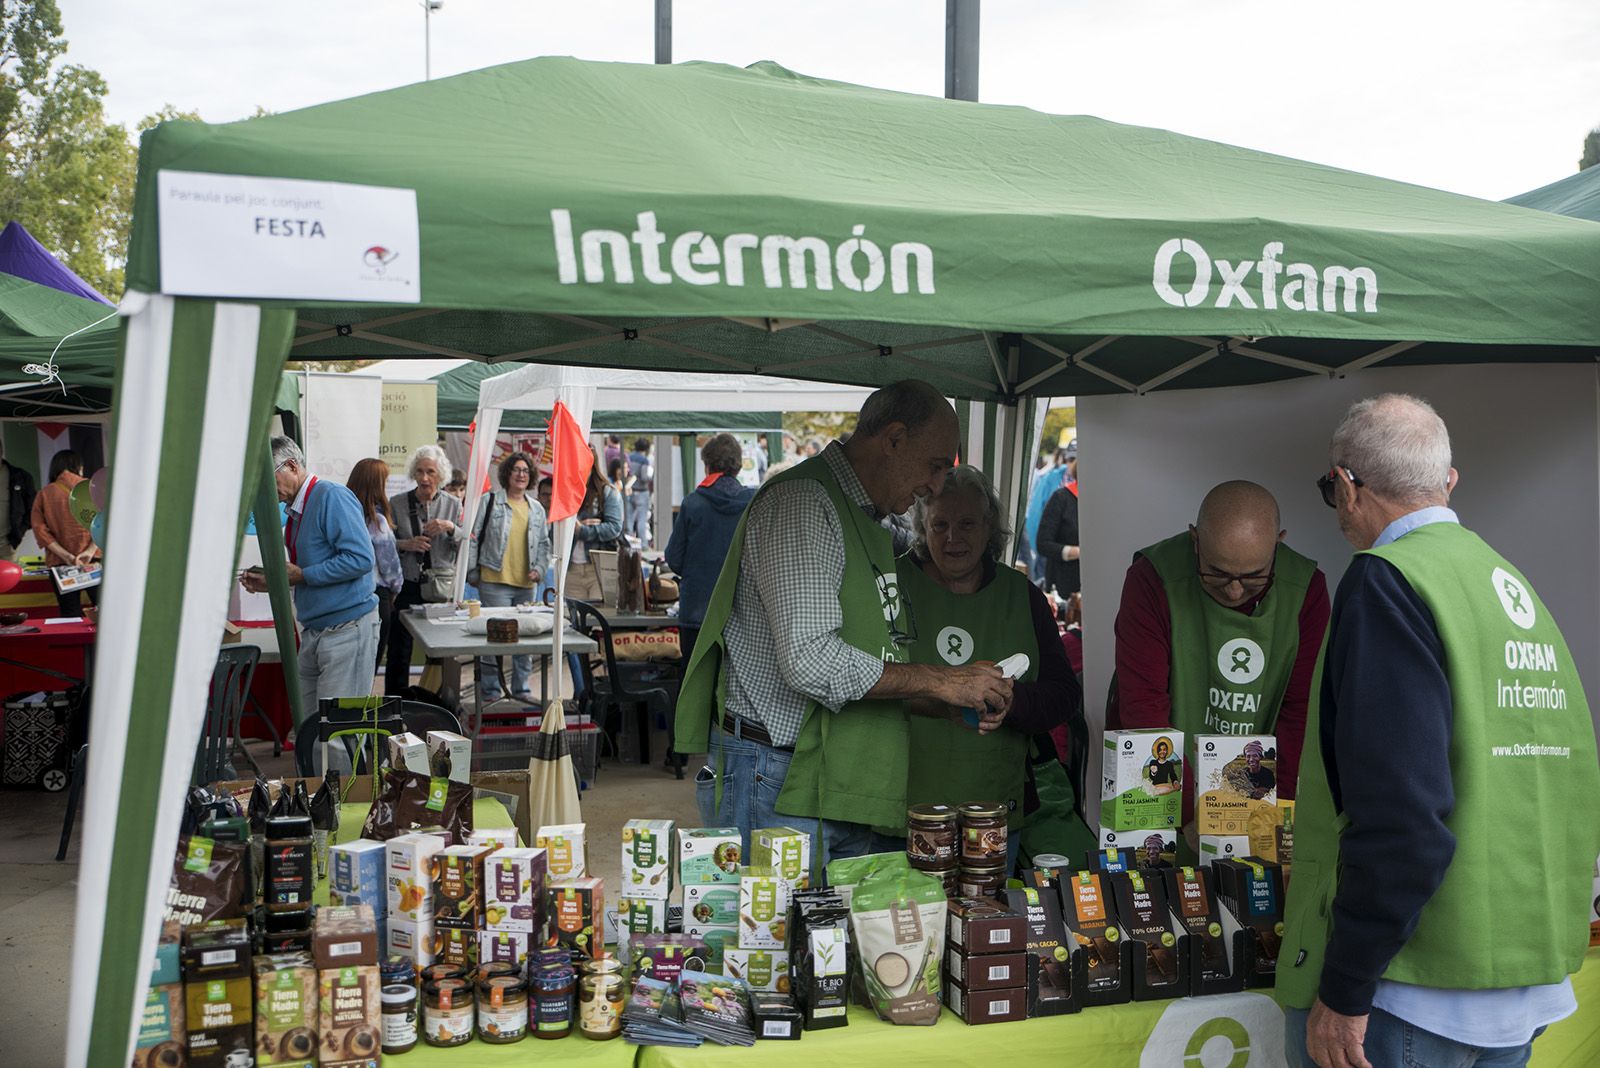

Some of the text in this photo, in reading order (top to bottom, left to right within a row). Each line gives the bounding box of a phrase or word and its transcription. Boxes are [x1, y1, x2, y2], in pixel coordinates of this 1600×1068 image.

[254, 217, 326, 238] FESTA
[550, 209, 1378, 312] Intermón Oxfam
[1504, 640, 1558, 672] OXFAM
[1205, 706, 1255, 735] Interm
[1136, 797, 1159, 805] JASMINE
[1183, 882, 1200, 890] Tierra
[1252, 881, 1268, 889] Tierra
[1133, 892, 1150, 900] Tierra
[1184, 890, 1201, 898] Madre
[1253, 889, 1269, 897] Madre
[167, 887, 207, 910] Tierra
[1134, 900, 1152, 908] Madre
[1027, 906, 1044, 914] Tierra
[1027, 914, 1046, 922] Madre
[272, 990, 298, 1001] Tierra
[335, 988, 362, 998] Tierra
[271, 1000, 300, 1012] Madre
[335, 998, 363, 1009] Madre
[203, 1003, 232, 1015] Tierra
[203, 1014, 233, 1027] Madre
